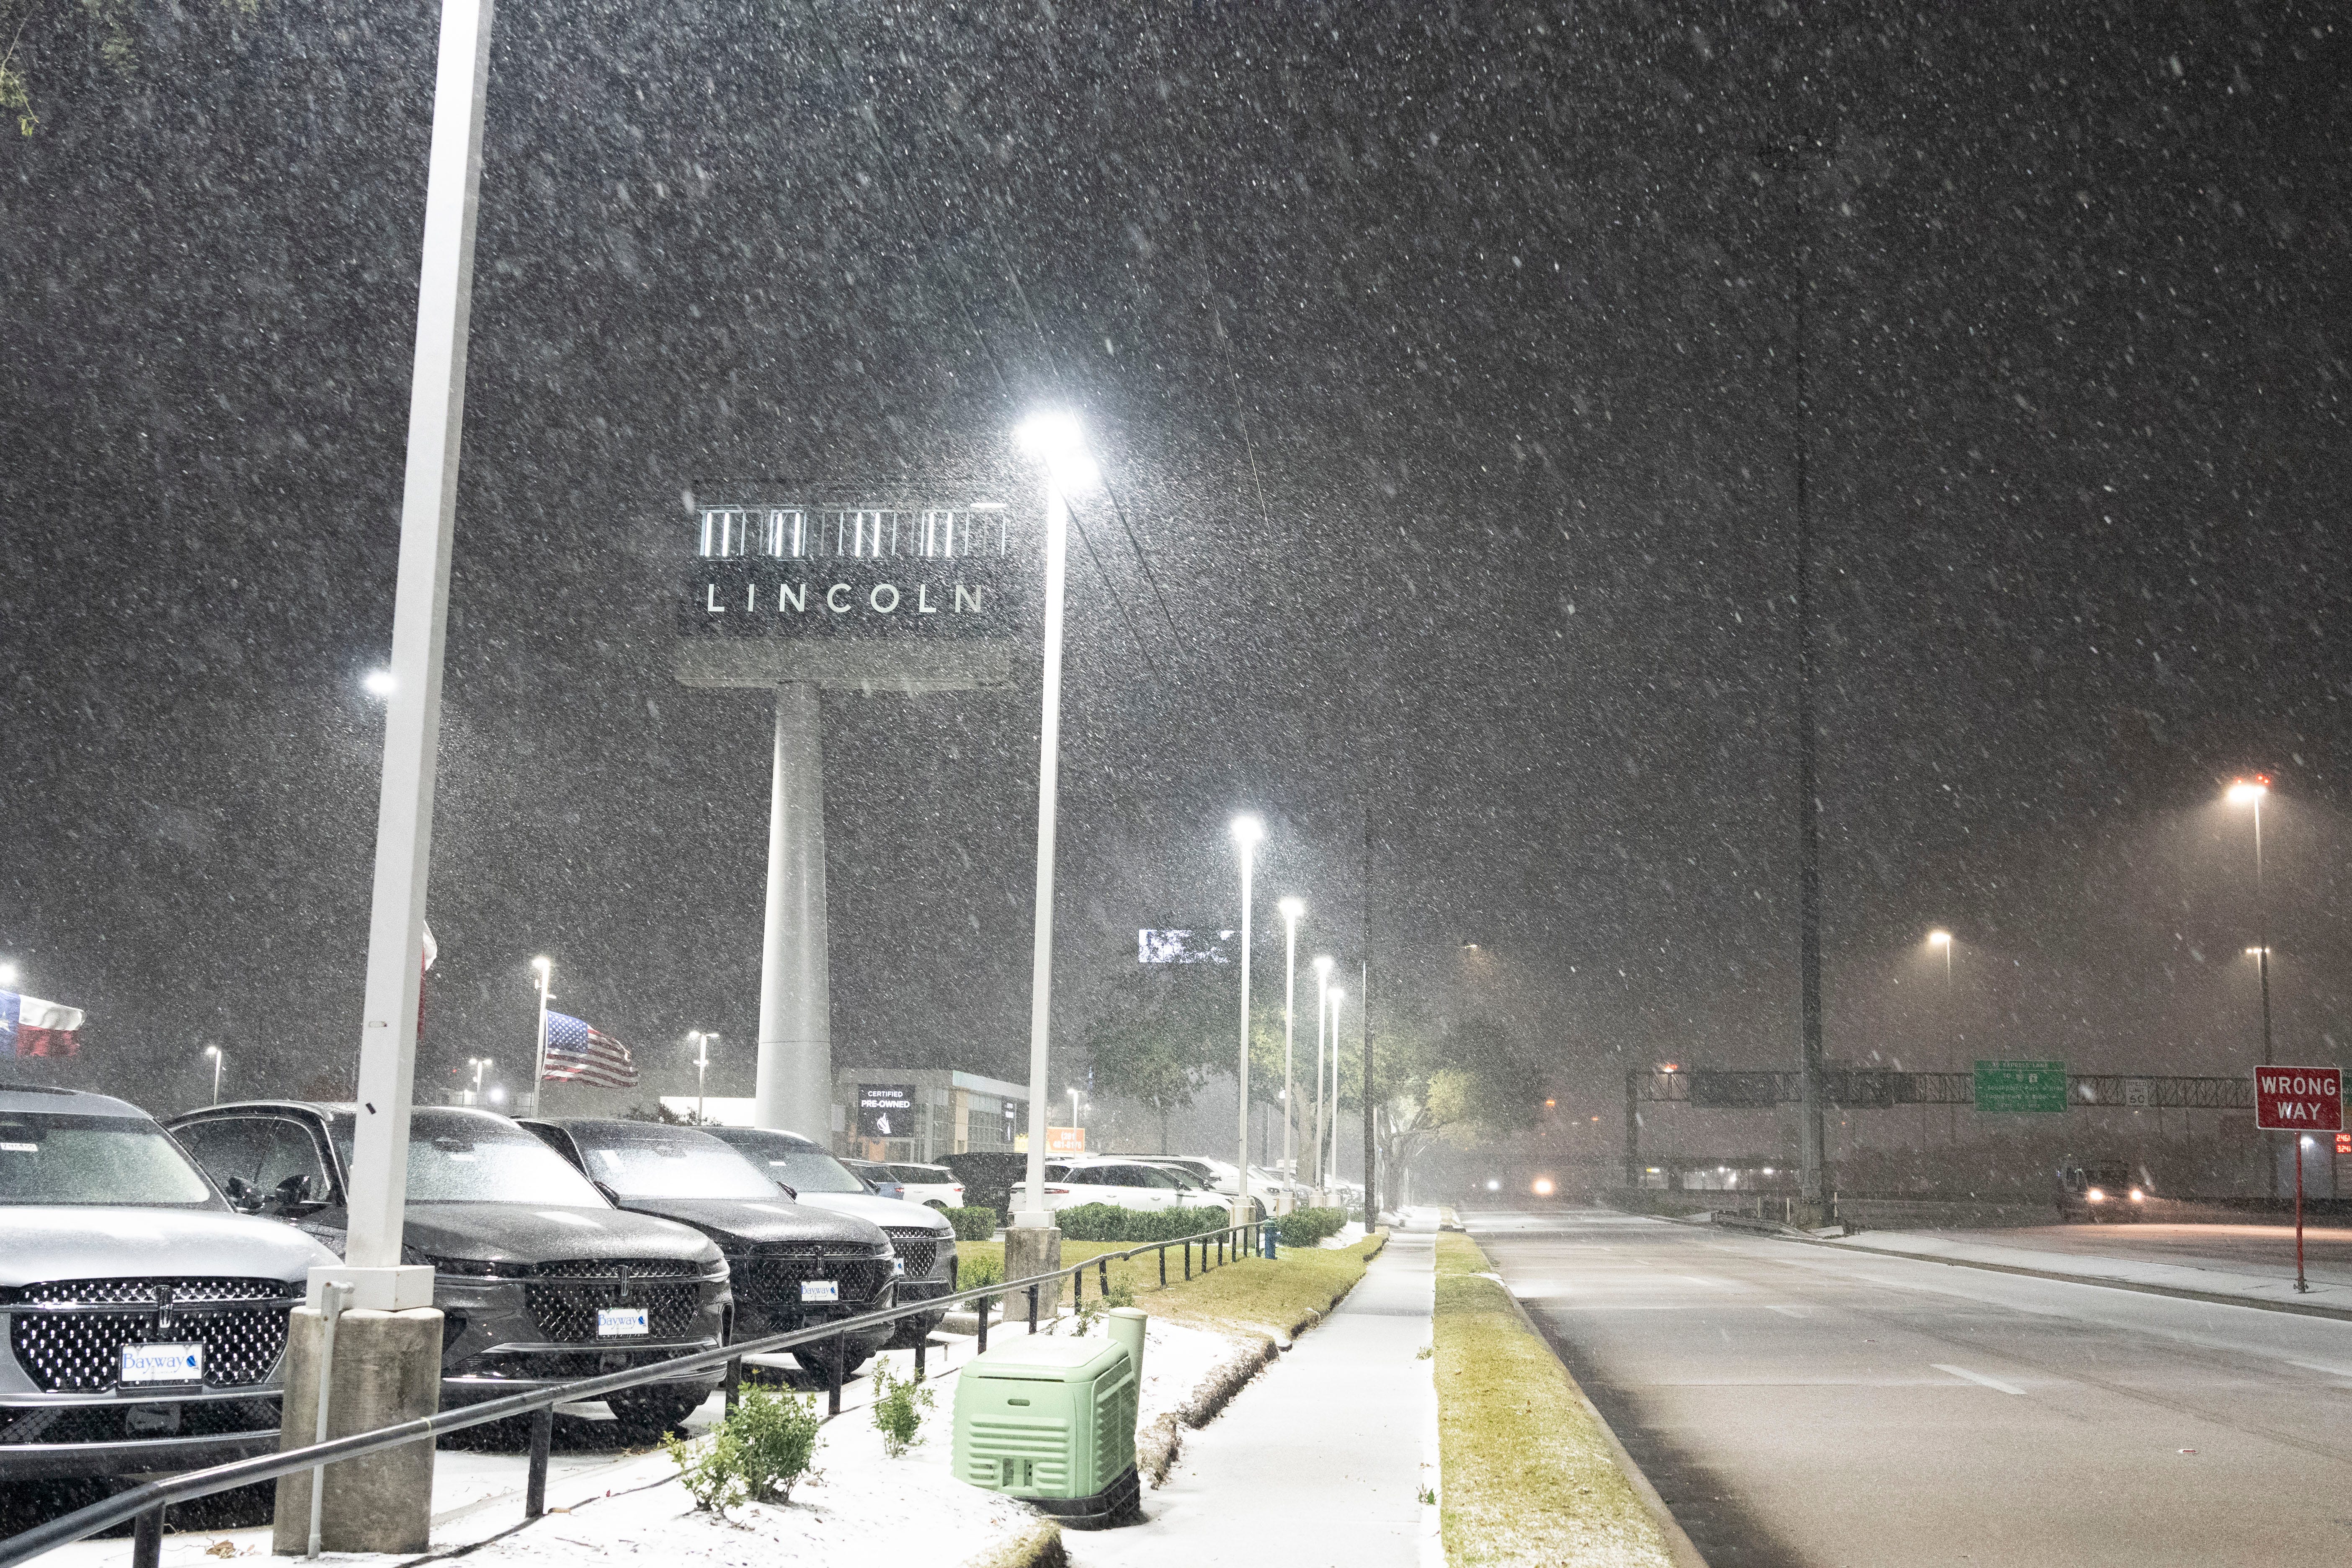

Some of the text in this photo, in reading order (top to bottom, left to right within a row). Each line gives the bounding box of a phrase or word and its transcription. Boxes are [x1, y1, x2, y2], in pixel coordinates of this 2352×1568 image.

[707, 583, 982, 613] LINCOLN
[2262, 1076, 2336, 1096] WRONG
[861, 1100, 910, 1108] PRE-OWNED
[2277, 1101, 2321, 1120] WAY
[1061, 1132, 1076, 1140] (281
[801, 1285, 830, 1297] Bayway
[598, 1314, 637, 1330] Bayway
[123, 1353, 185, 1374] Bayway
